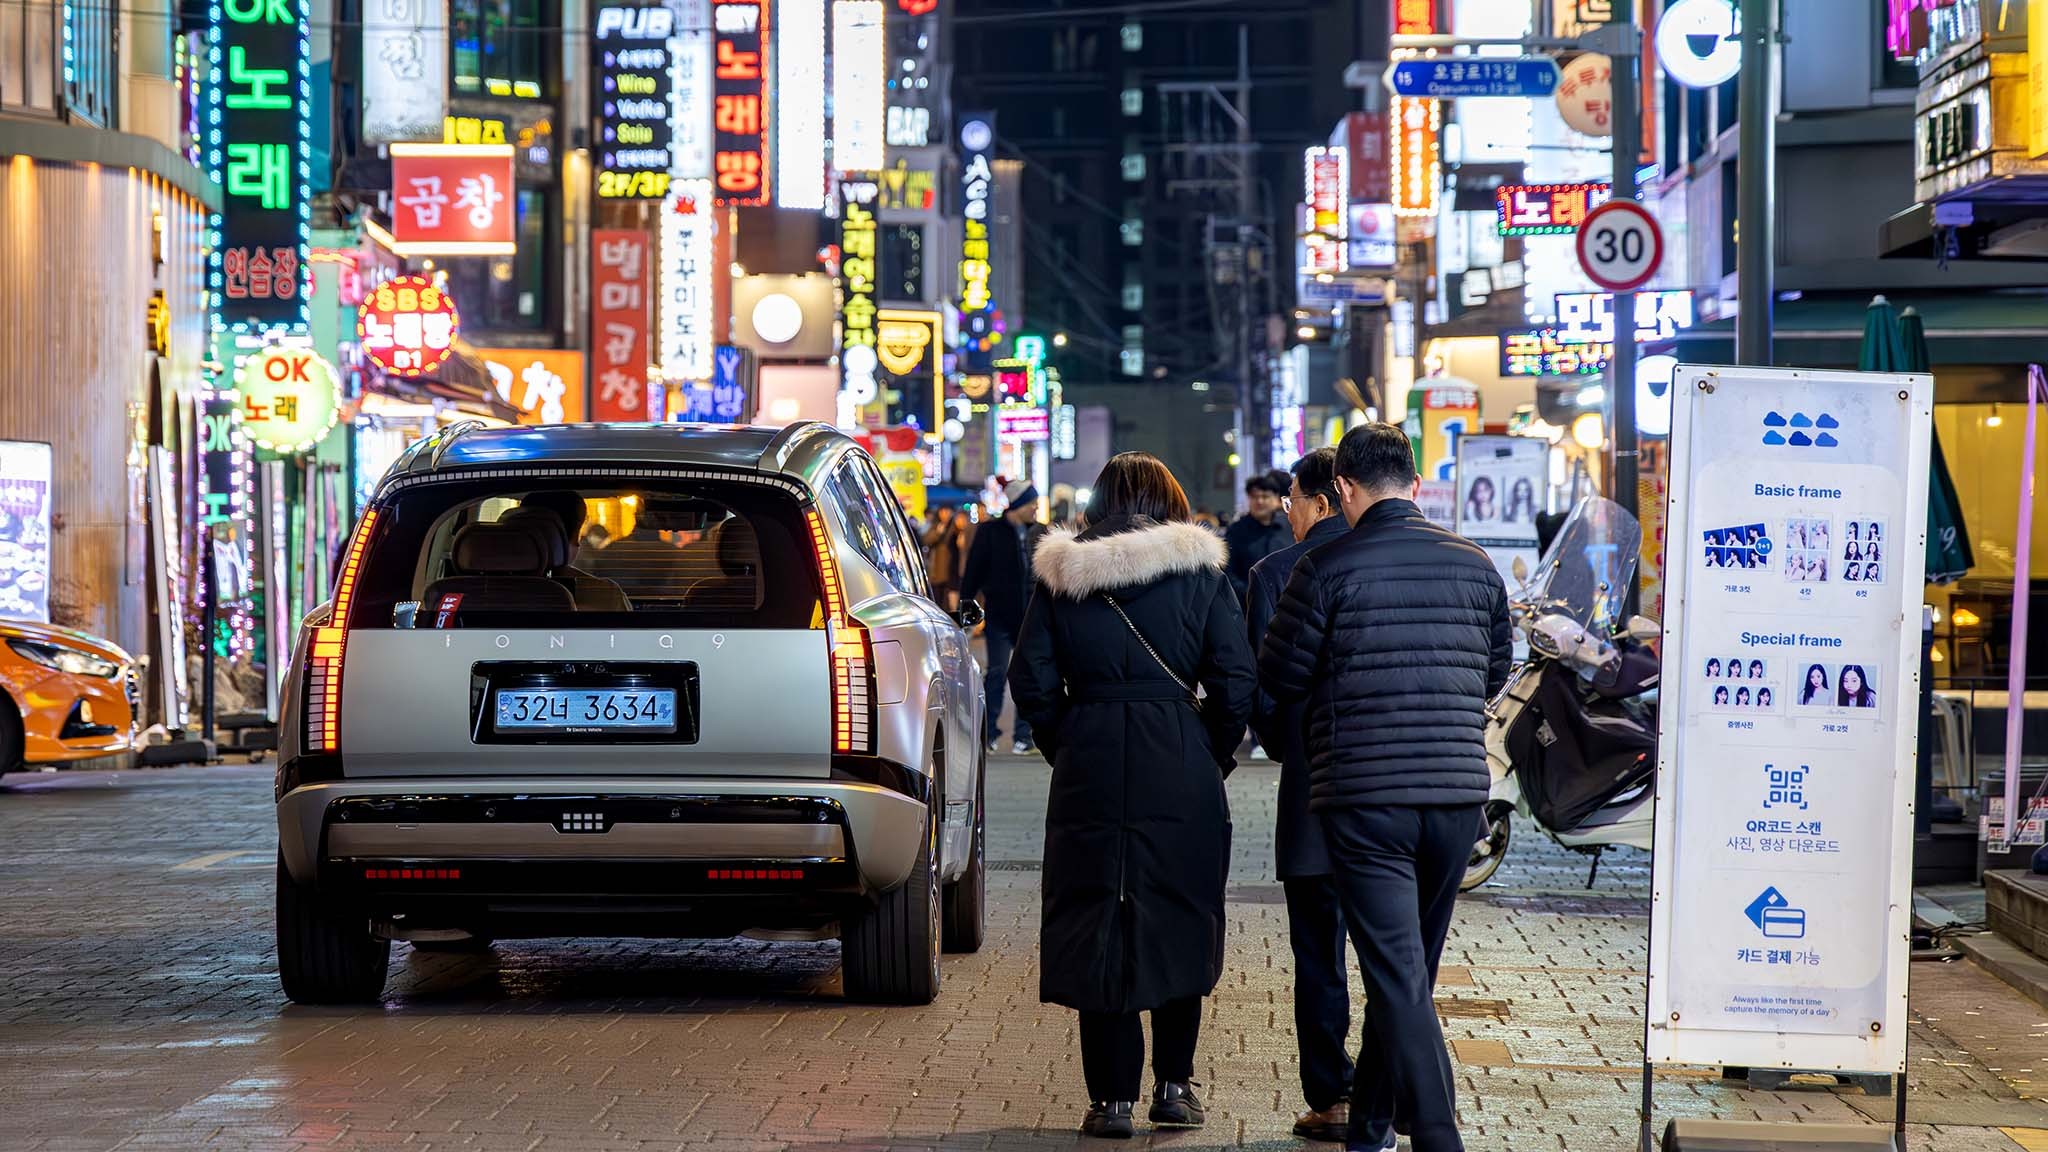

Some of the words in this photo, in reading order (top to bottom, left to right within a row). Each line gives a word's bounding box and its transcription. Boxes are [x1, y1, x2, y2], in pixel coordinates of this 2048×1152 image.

[597, 8, 674, 39] PUB
[1433, 64, 1517, 82] 오금로13길
[617, 73, 657, 94] Wine
[616, 98, 666, 120] Vodka
[716, 40, 761, 191] 노래방
[225, 46, 292, 209] 노래
[598, 171, 671, 197] 2F/3F
[399, 173, 504, 230] 곱창
[1595, 228, 1644, 264] 30
[224, 247, 297, 298] 연습장
[376, 288, 441, 312] SBS
[365, 312, 452, 349] 노래방
[394, 351, 422, 368] B1
[265, 357, 311, 382] OK
[244, 394, 297, 423] 노래
[1754, 483, 1795, 497] Basic
[1799, 484, 1842, 499] frame
[1757, 542, 1771, 551] 1+1
[1724, 585, 1738, 593] 가로
[1799, 588, 1812, 596] 4컷
[1855, 589, 1868, 598] 6컷
[711, 634, 726, 649] 9
[1741, 632, 1795, 647] Special
[1799, 633, 1842, 648] frame
[513, 695, 568, 721] 32너
[584, 695, 658, 721] 3634
[1822, 724, 1836, 733] 가로
[1837, 725, 1849, 733] 2컷
[1746, 820, 1792, 833] QR코드
[1795, 821, 1821, 835] 스캔
[1726, 836, 1755, 852] 사진,
[1759, 837, 1784, 852] 영상
[1789, 839, 1840, 853] 다운로드
[1737, 948, 1763, 963] 카드
[1766, 949, 1791, 964] 결제
[1795, 951, 1820, 966] 가능
[1732, 995, 1759, 1005] Always
[1775, 997, 1788, 1005] the
[1789, 997, 1804, 1005] first
[1805, 998, 1822, 1006] time
[1724, 1005, 1753, 1014] capture
[1754, 1006, 1767, 1014] the
[1768, 1008, 1798, 1016] memory
[1800, 1007, 1808, 1015] of
[1816, 1009, 1831, 1017] day
